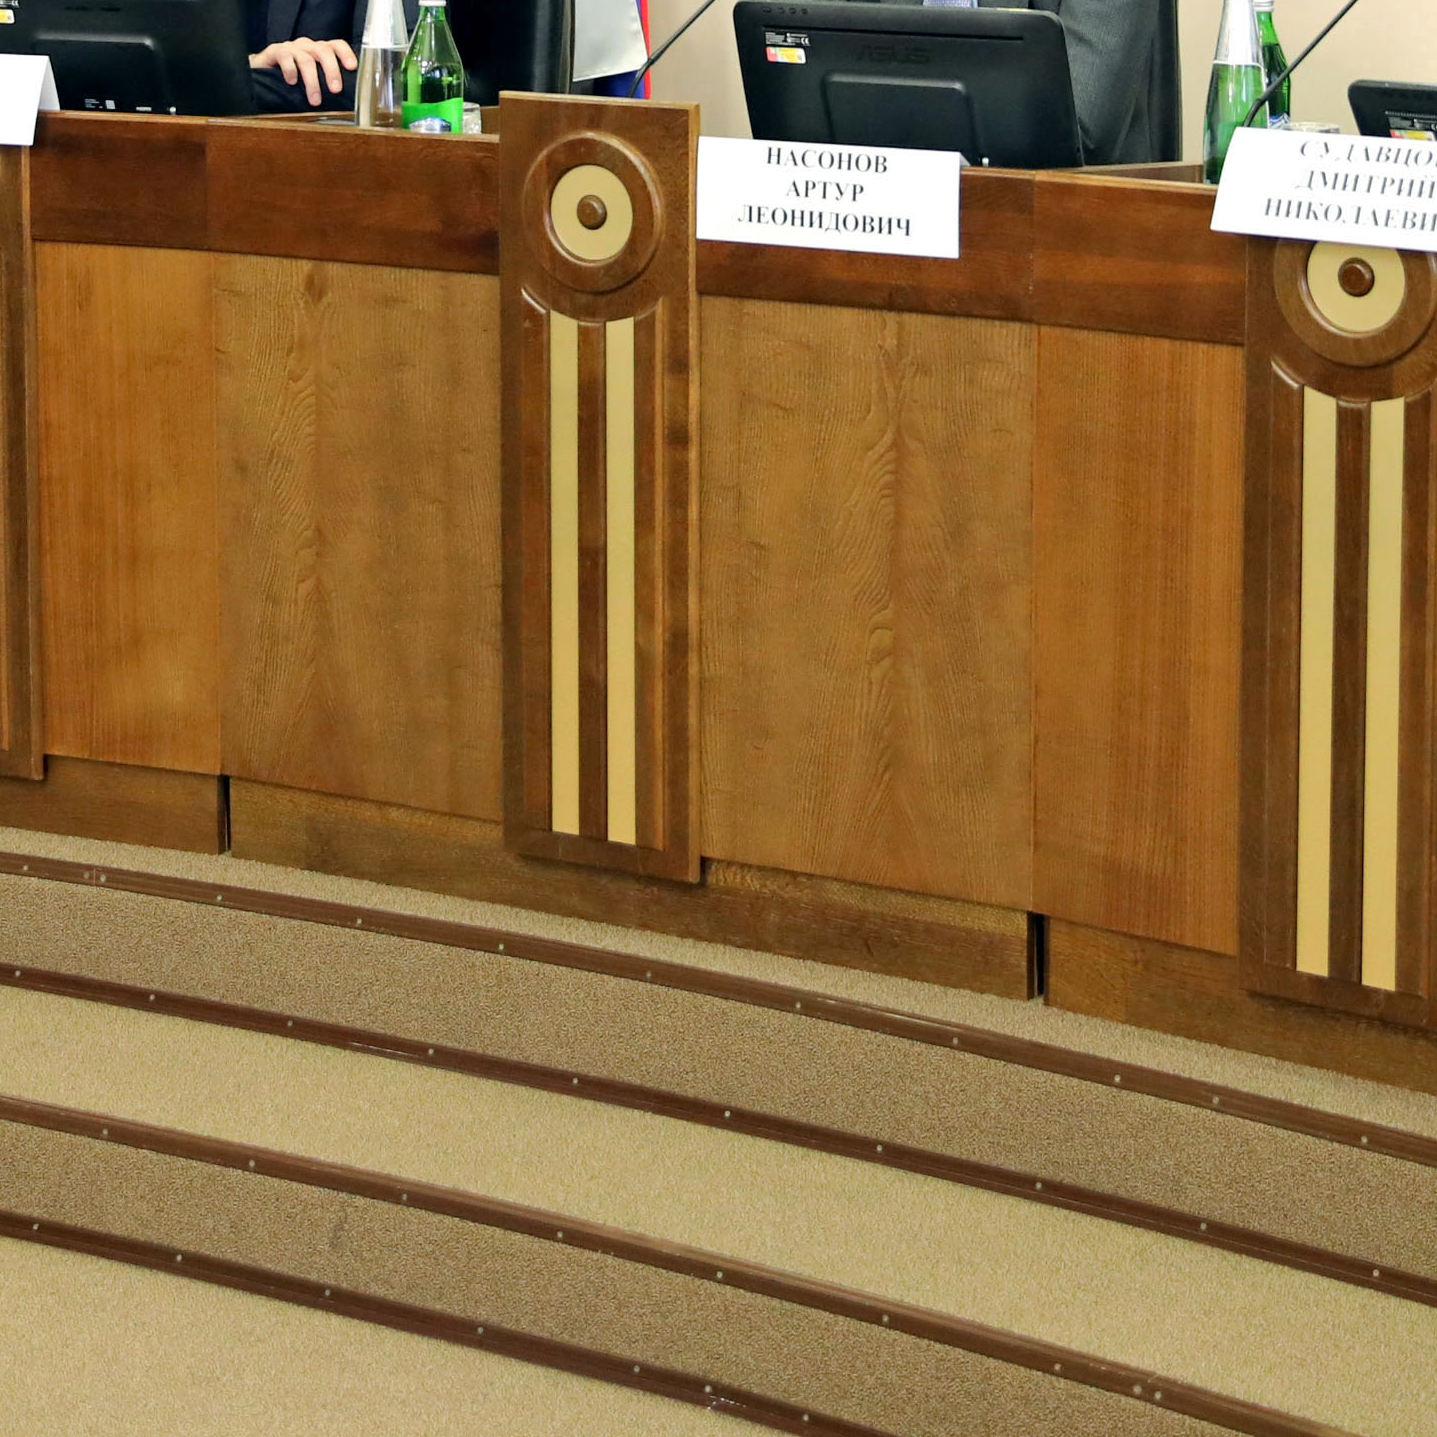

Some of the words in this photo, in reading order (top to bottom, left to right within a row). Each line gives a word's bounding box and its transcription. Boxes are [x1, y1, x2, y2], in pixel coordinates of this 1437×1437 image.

[766, 146, 888, 174] НАСОНОВ
[786, 179, 864, 202] АРТУР
[1294, 169, 1436, 199] ДМИТРИЙ
[737, 204, 911, 237] ЛЕОНИДОВИЧ
